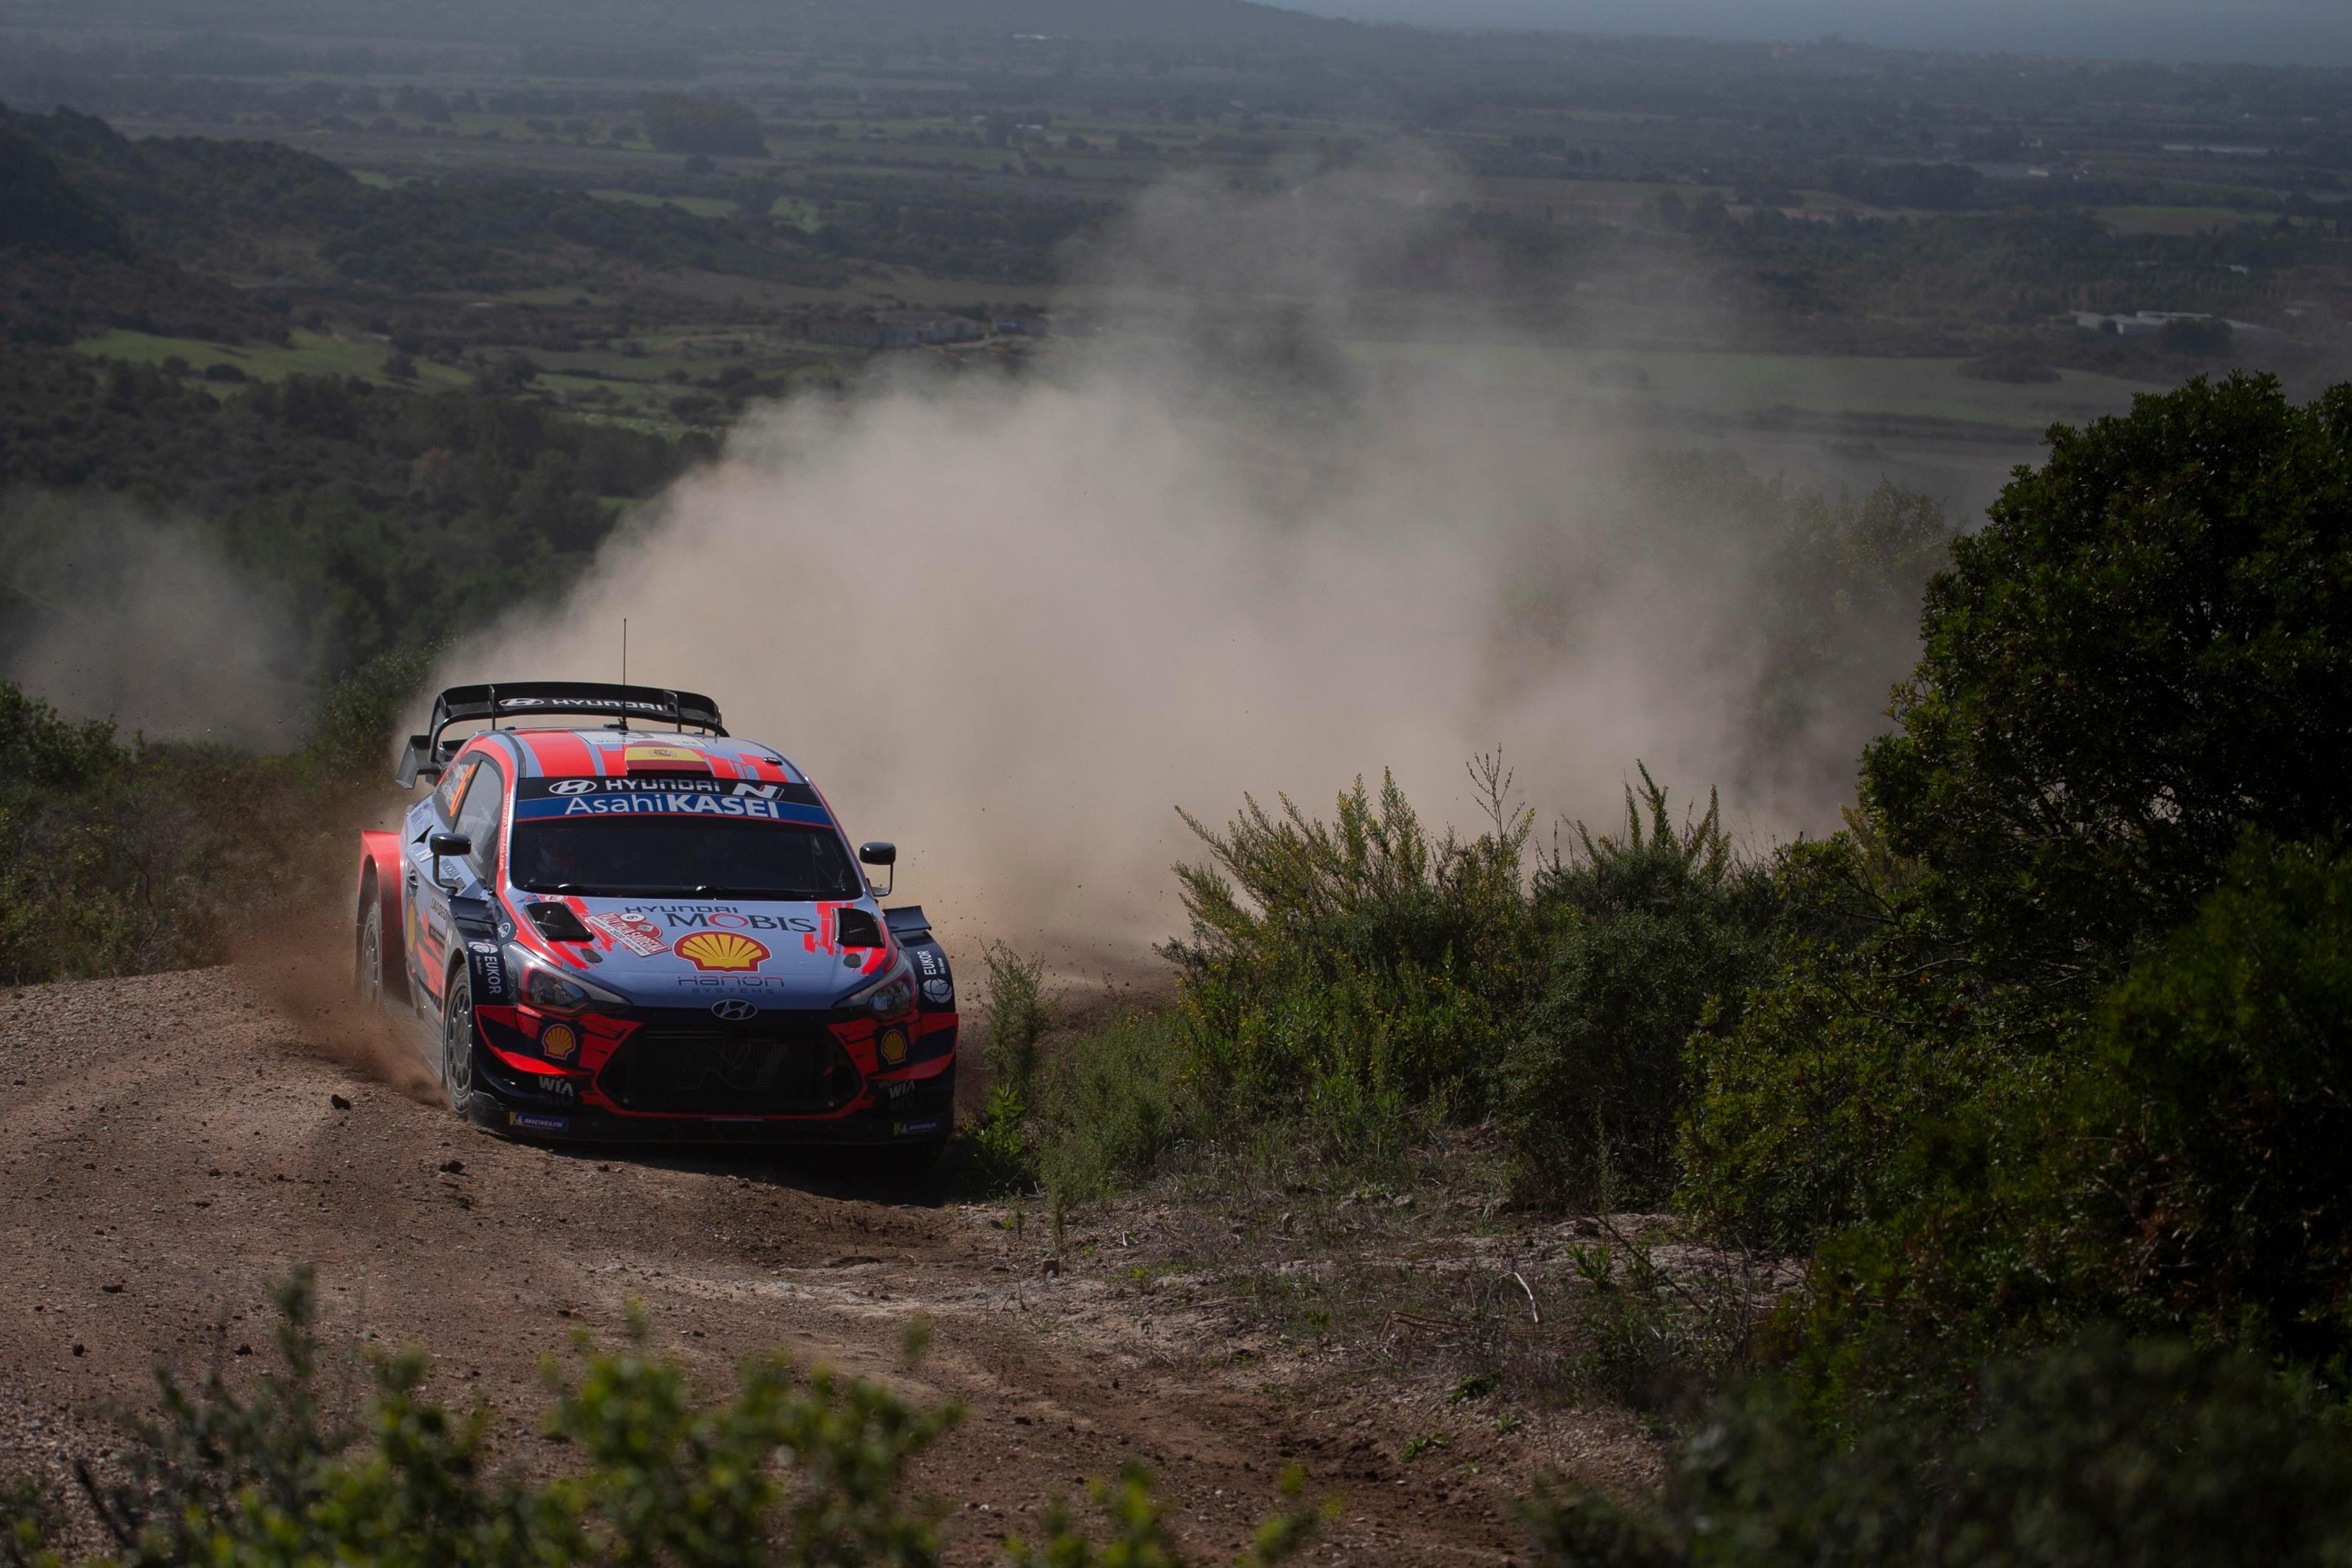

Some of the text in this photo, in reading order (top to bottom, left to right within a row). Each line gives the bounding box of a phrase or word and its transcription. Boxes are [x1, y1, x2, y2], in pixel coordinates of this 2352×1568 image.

[551, 698, 663, 711] HYUNDAI
[605, 779, 720, 792] HYUNDAI
[564, 793, 779, 819] AsahiKASEI
[624, 905, 738, 914] HYUNDAI
[660, 913, 817, 933] MOBIS
[917, 950, 936, 975] EUKOR
[484, 956, 501, 994] EUKOR
[691, 987, 775, 995] SYSTEMS
[524, 1118, 564, 1128] MICHELIN
